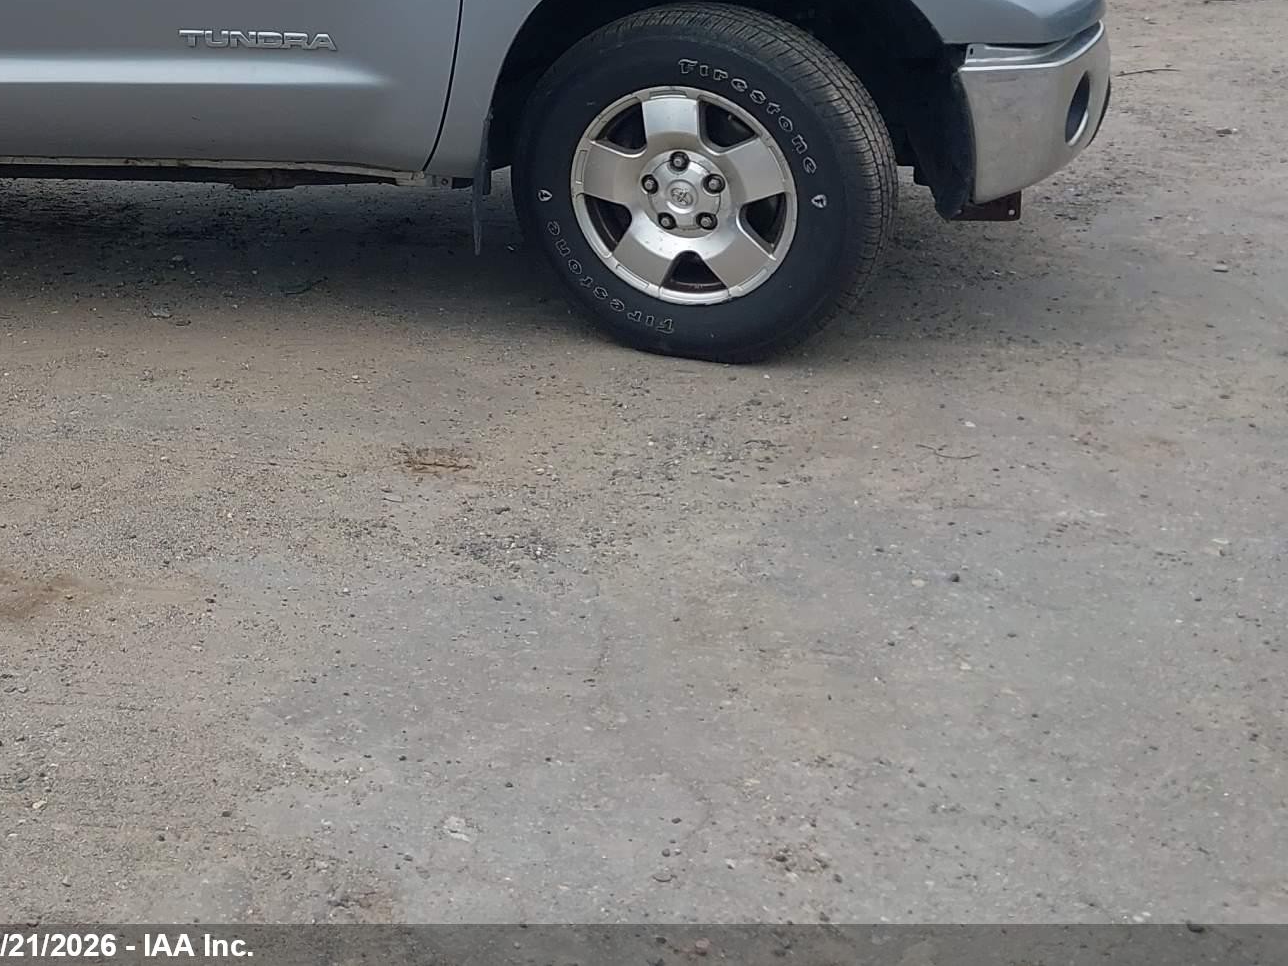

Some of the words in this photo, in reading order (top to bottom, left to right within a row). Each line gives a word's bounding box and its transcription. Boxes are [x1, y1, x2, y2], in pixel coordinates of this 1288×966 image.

[179, 29, 337, 51] TUNDRA
[678, 58, 817, 175] Firestone
[546, 220, 673, 334] Firestone
